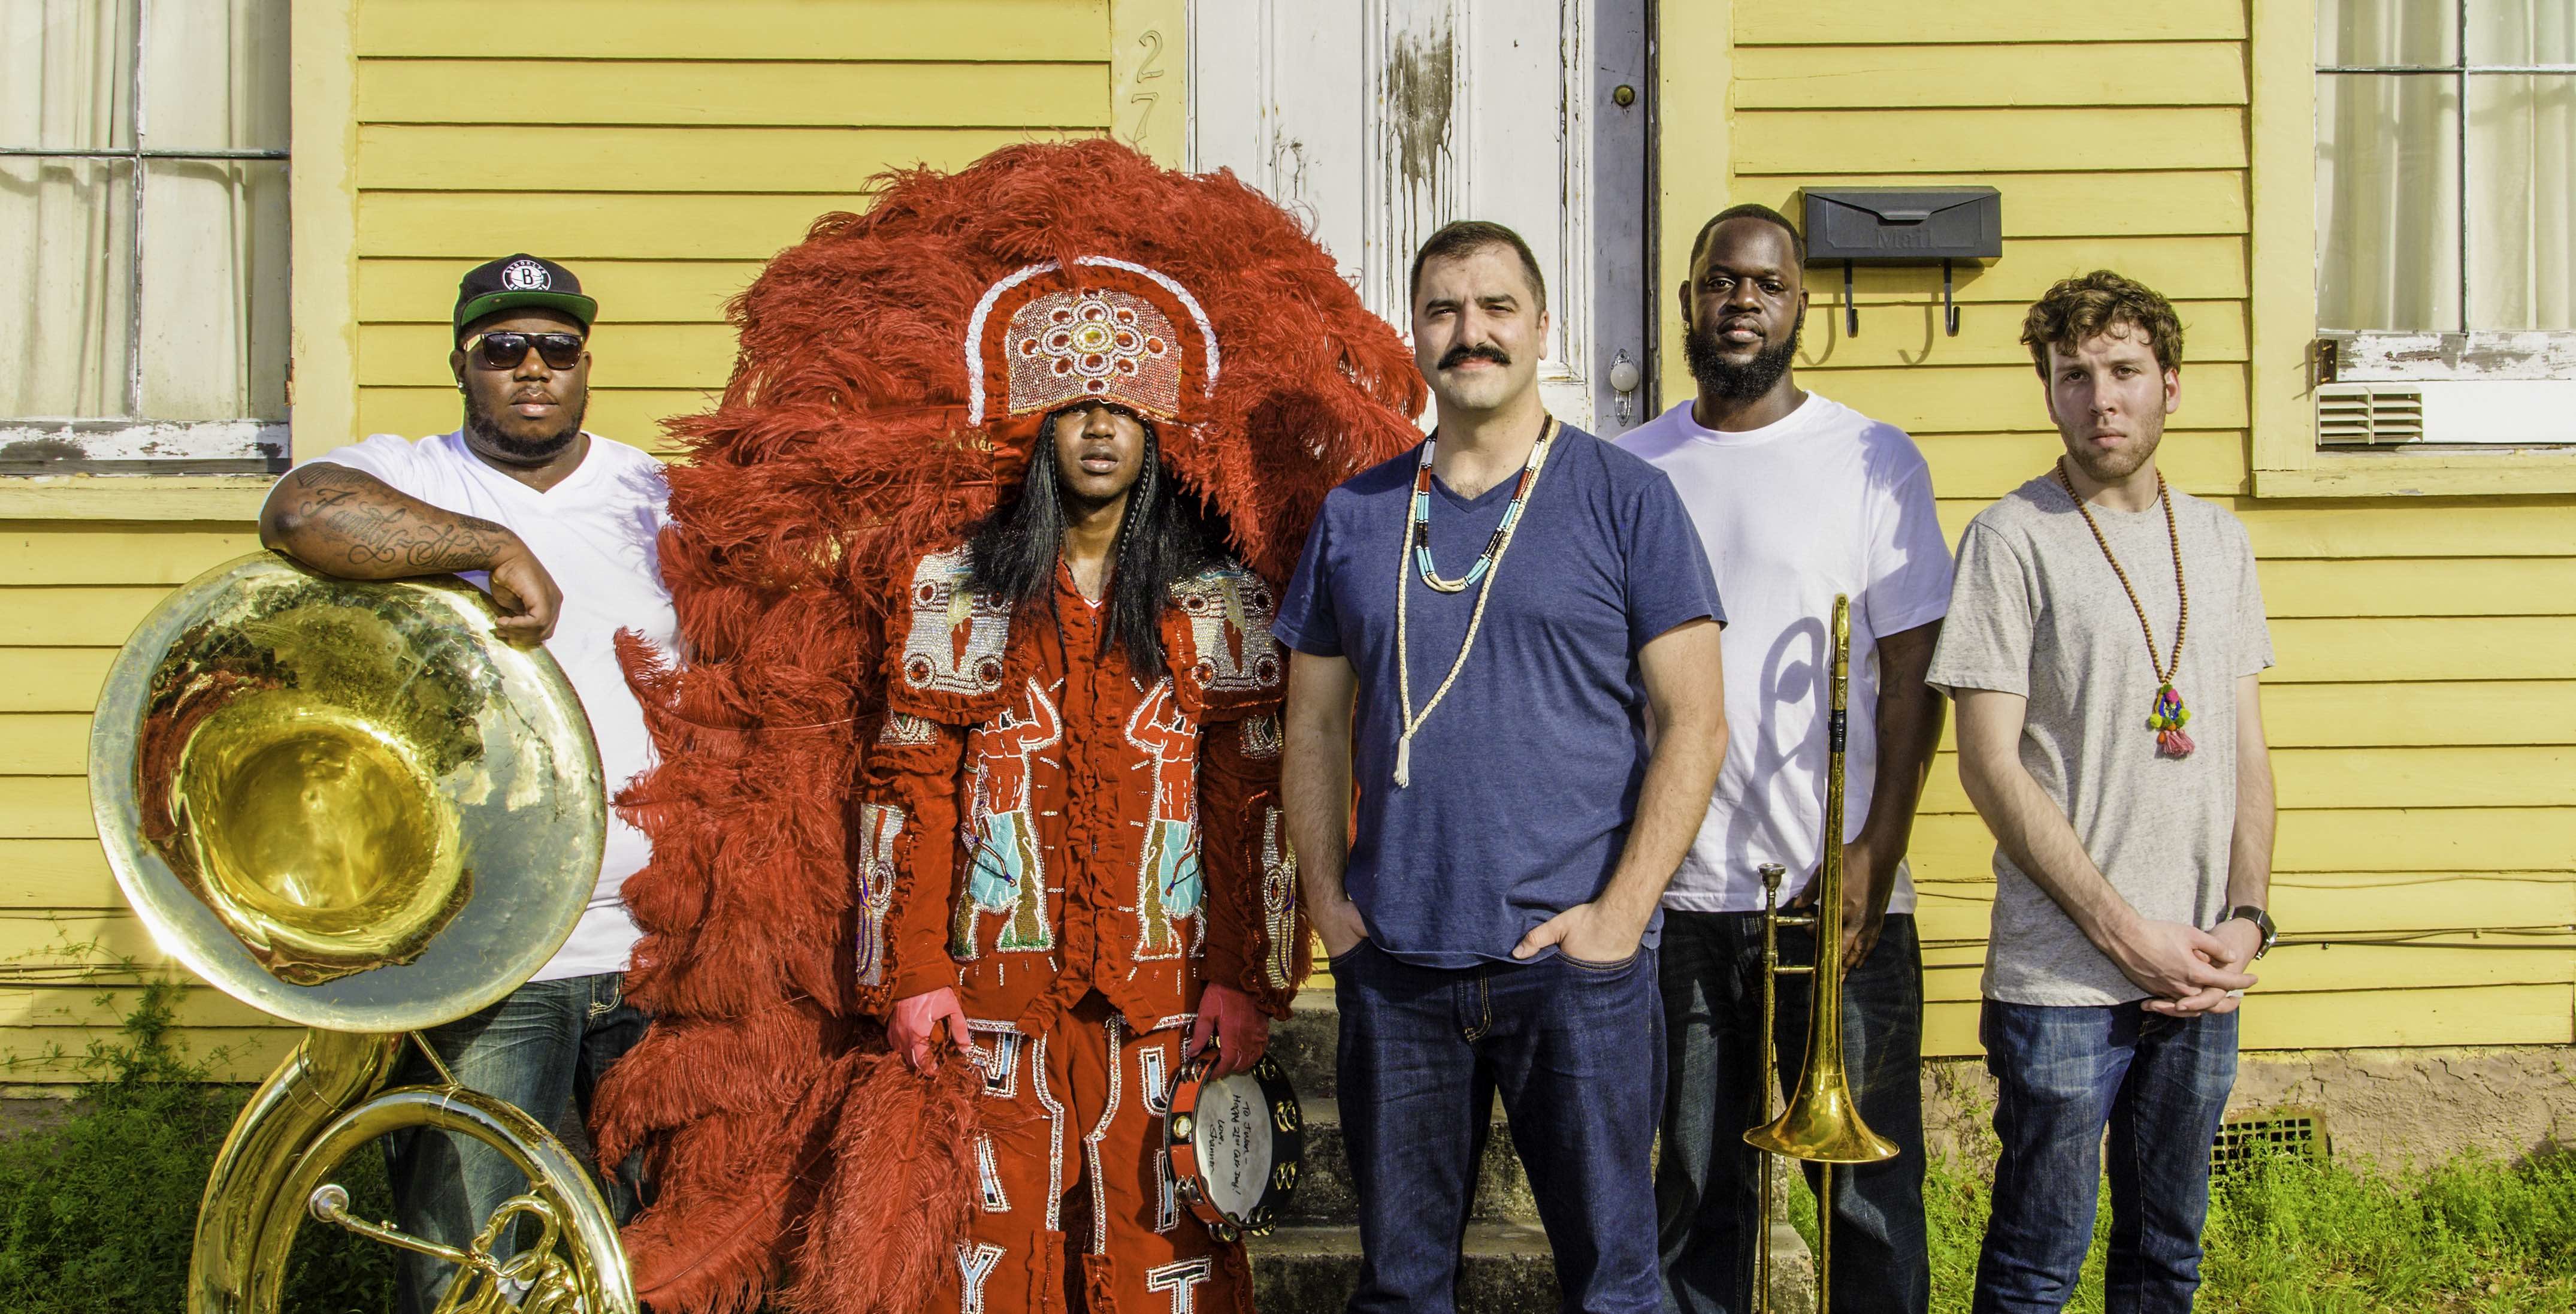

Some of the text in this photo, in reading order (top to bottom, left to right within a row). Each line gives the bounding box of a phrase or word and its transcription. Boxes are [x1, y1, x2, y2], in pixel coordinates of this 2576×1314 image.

[1131, 29, 1165, 155] 27
[1873, 227, 1934, 249] Mail
[522, 268, 534, 285] B
[1230, 1094, 1241, 1123] Happy
